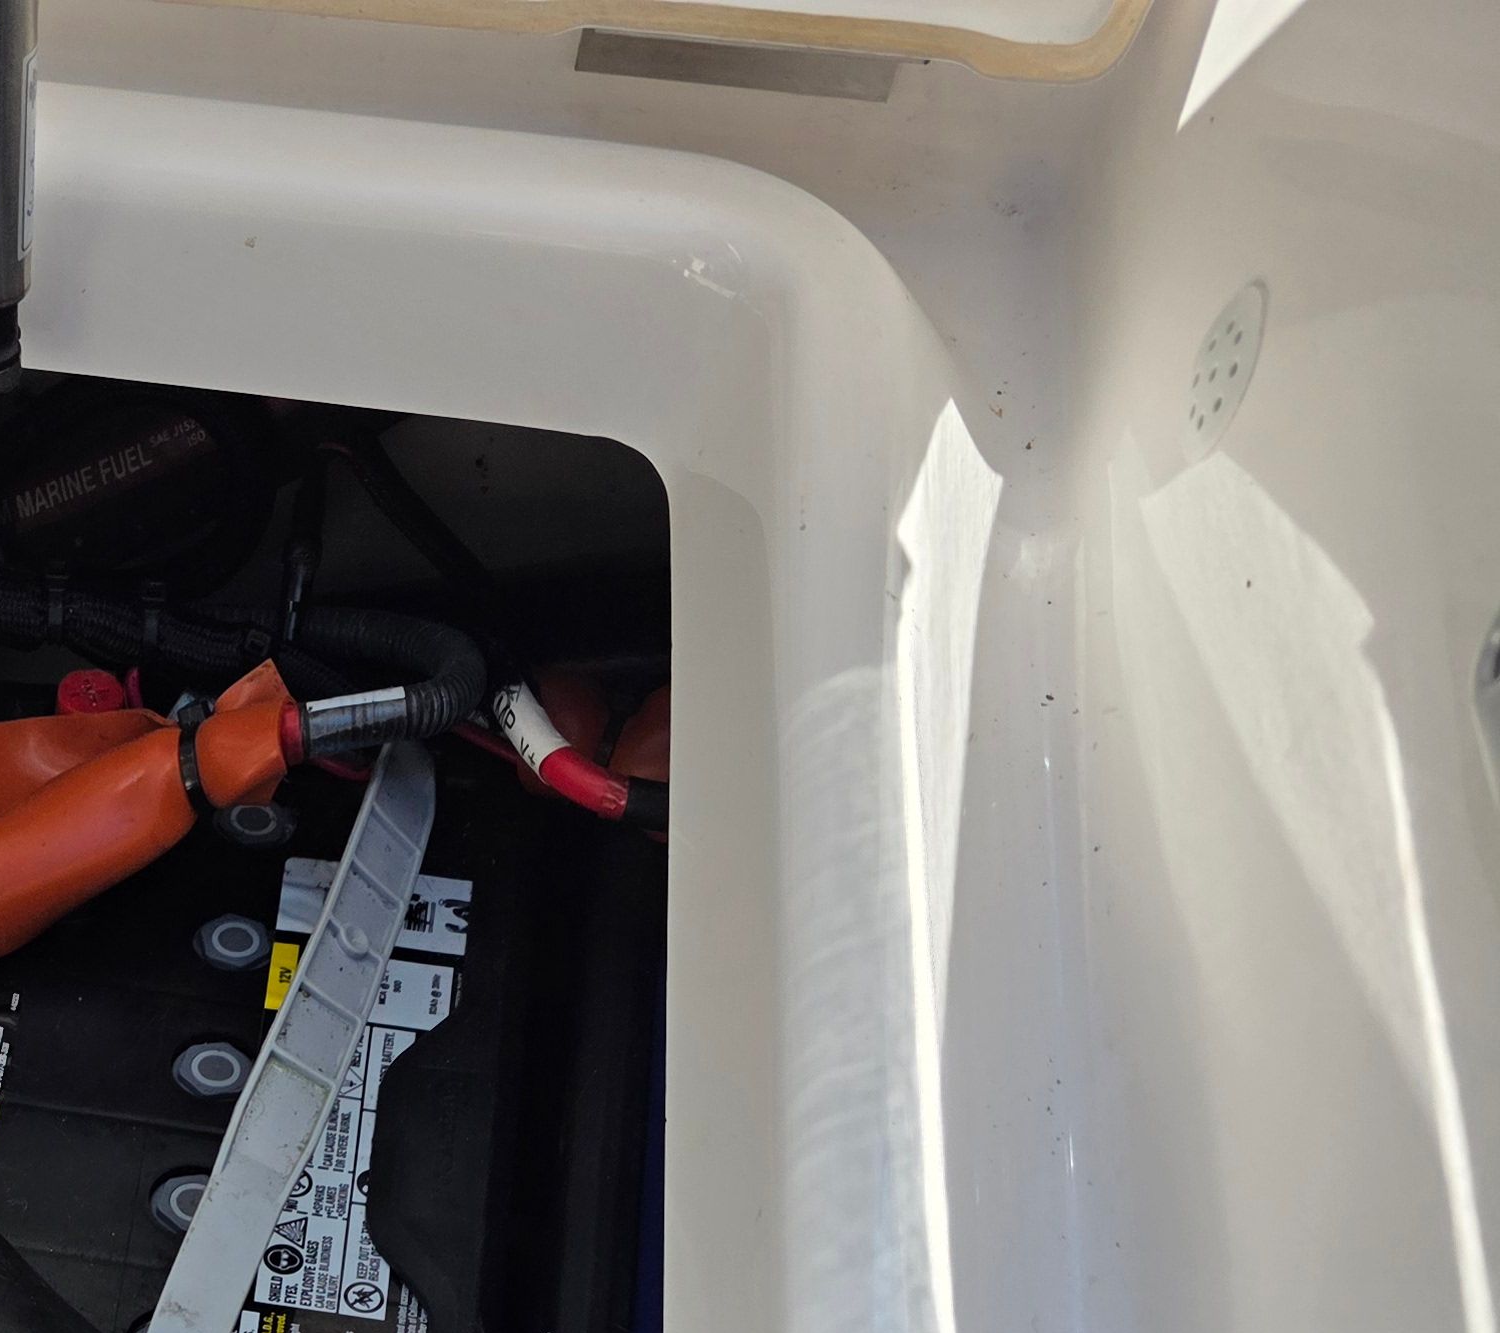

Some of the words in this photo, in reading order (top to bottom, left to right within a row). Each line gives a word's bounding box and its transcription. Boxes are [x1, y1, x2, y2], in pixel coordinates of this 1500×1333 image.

[11, 464, 100, 520] MARINE
[94, 440, 155, 486] FUEL
[278, 966, 292, 984] 12V
[305, 1240, 319, 1264] GASES
[355, 1261, 369, 1279] KEEP
[268, 1275, 283, 1302] SHIELD
[284, 1282, 298, 1304] EYES.
[299, 1265, 316, 1306] EXPLOSIVE
[315, 1272, 328, 1294] CAUSE
[314, 1294, 325, 1308] CAN
